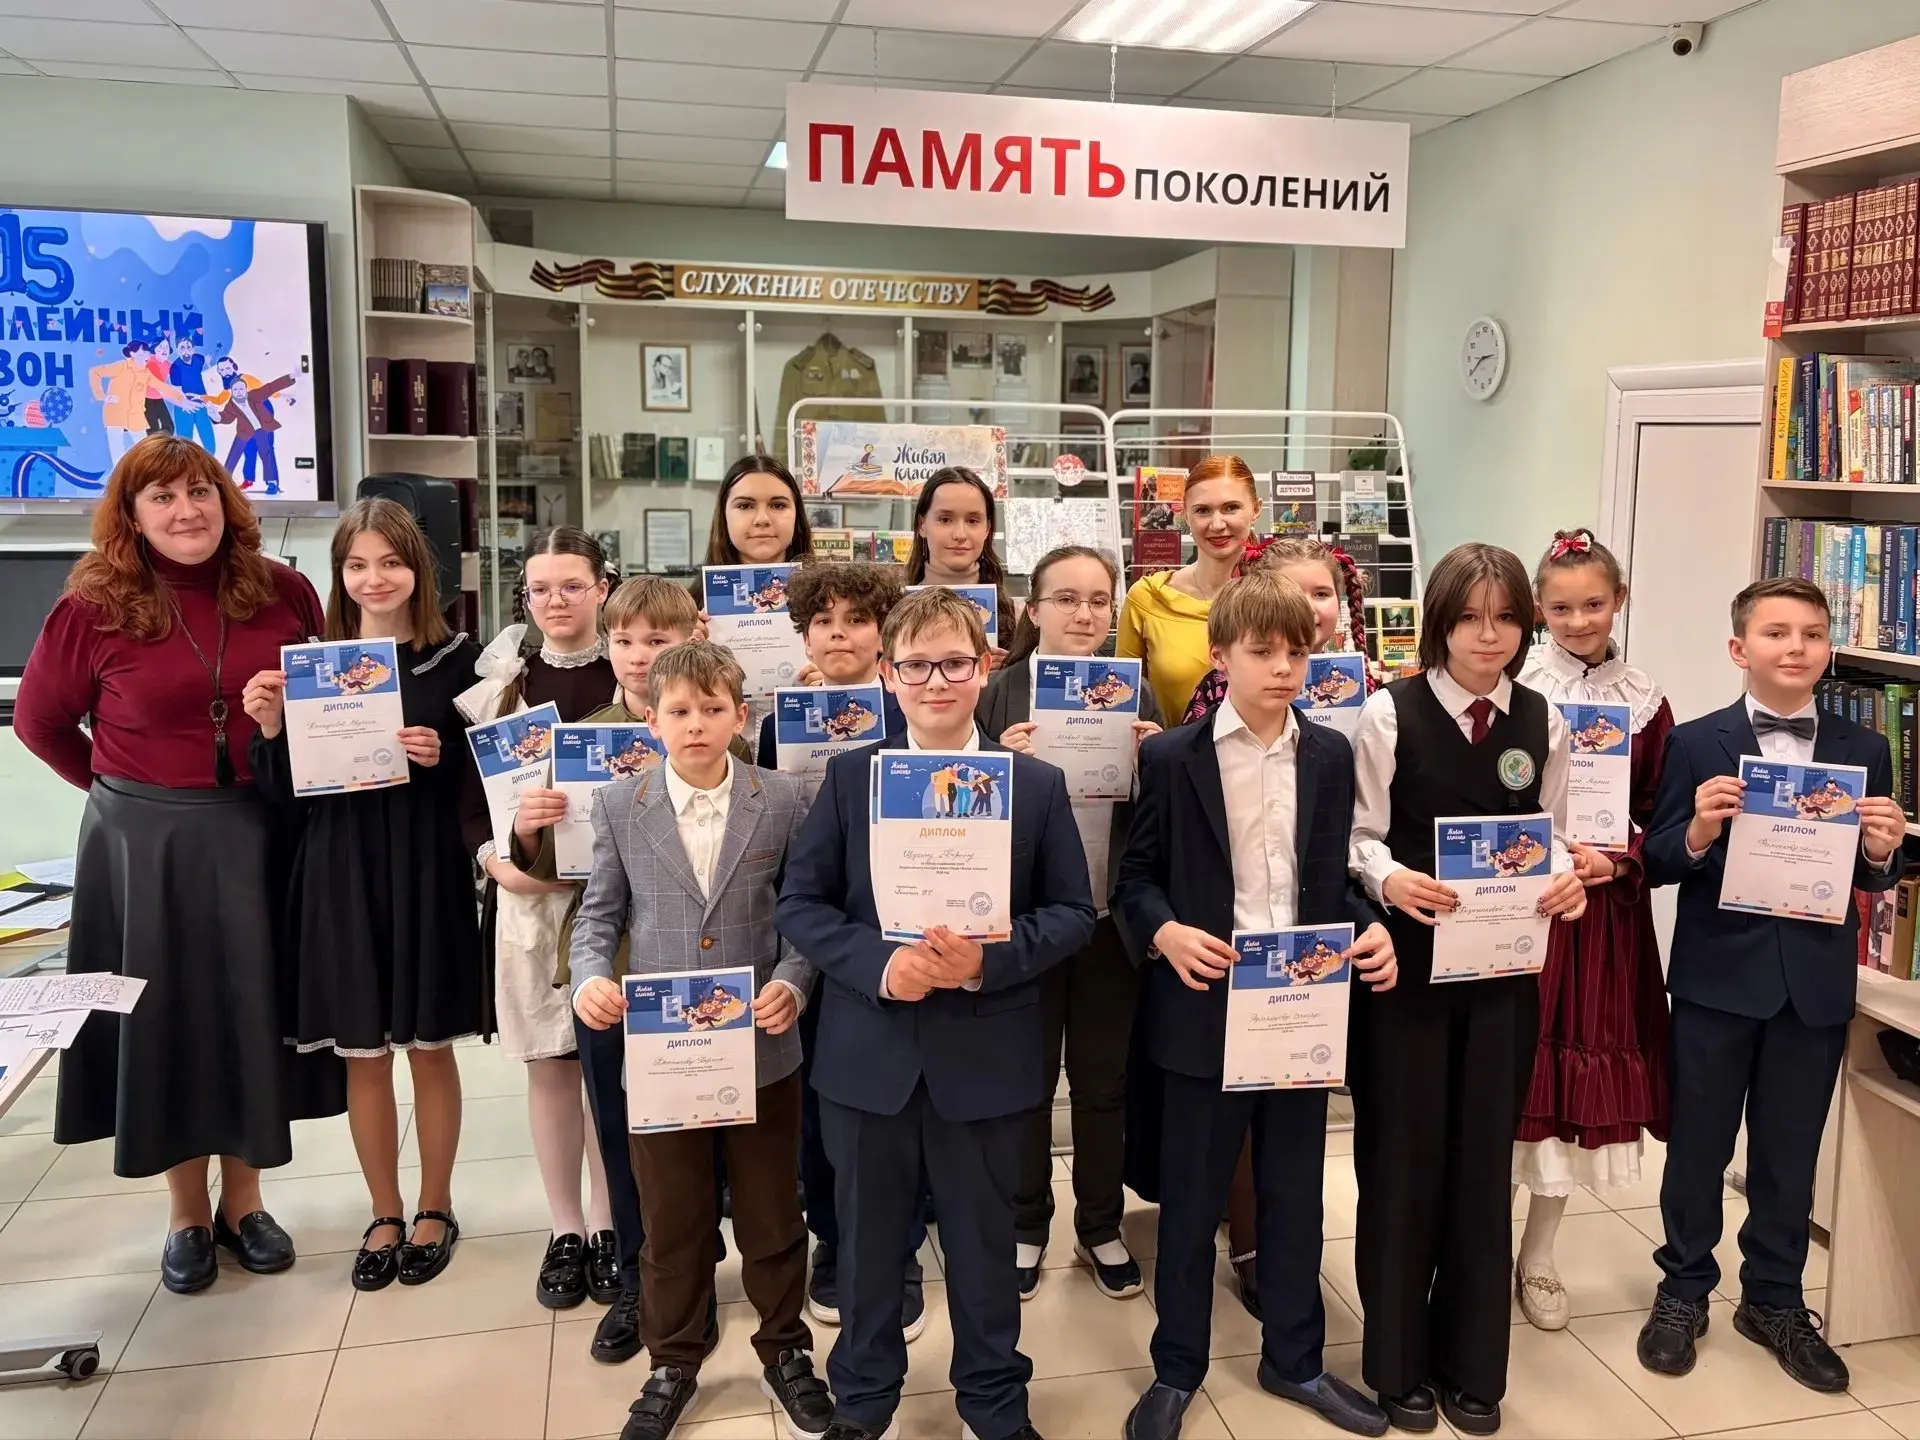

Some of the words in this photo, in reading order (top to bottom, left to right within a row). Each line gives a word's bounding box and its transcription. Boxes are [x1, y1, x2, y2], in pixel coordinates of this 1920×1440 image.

[808, 121, 1126, 199] ПАМЯТЬ
[1133, 166, 1391, 214] ПОКОЛЕНИЙ
[679, 268, 824, 302] СЛУЖЕНИЕ
[828, 274, 971, 307] ОТЕЧЕСТВУ
[893, 443, 946, 465] Живая
[894, 465, 938, 482] класс
[1853, 534, 1861, 558] ДЕТЕЙ
[1882, 569, 1890, 622] ЭНЦИКЛОПЕДИЯ
[737, 619, 772, 628] ДИПЛОМ
[323, 701, 364, 713] ДИПЛОМ
[1066, 717, 1103, 725] ДИПЛОМ
[1903, 729, 1911, 759] МИРА
[511, 768, 542, 785] ДИПЛОМ
[1903, 762, 1911, 804] СТРАНЫ
[919, 827, 966, 839] ДИПЛОМ
[1771, 823, 1817, 836] ДИПЛОМ
[1475, 884, 1516, 896] ДИПЛОМ
[1268, 992, 1310, 1005] ДИПЛОМ
[666, 1037, 712, 1049] ДИПЛОМ
